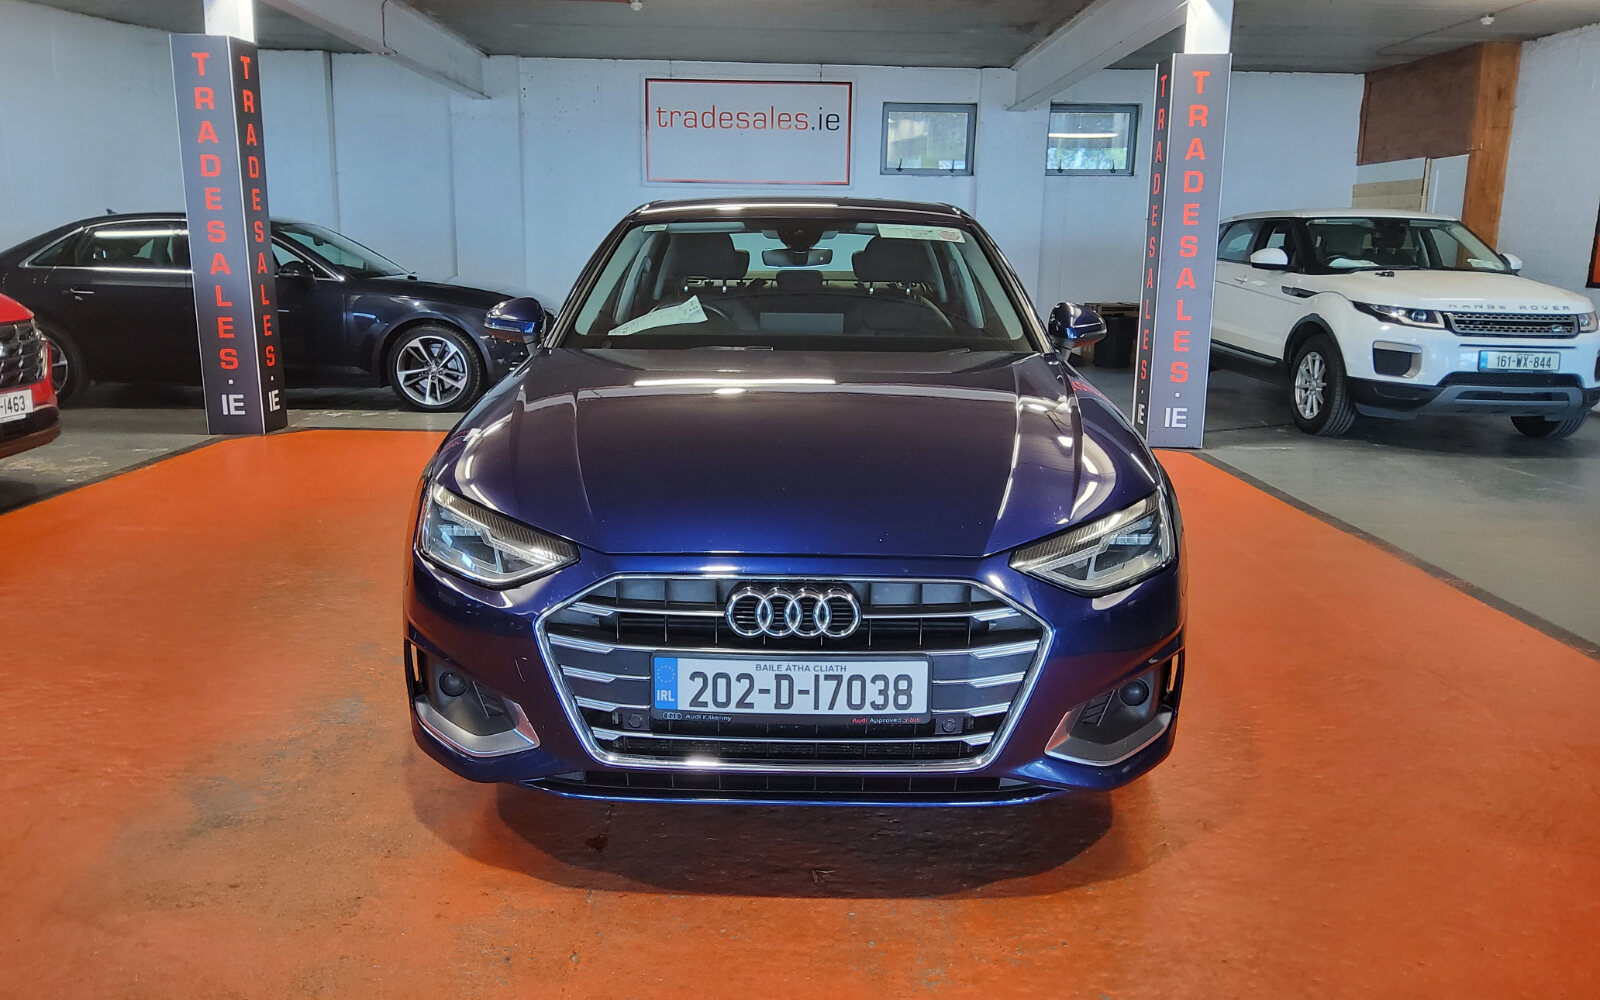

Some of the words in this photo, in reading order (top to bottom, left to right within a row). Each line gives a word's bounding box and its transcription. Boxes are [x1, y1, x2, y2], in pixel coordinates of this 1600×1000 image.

[655, 104, 840, 131] tradesales.ie
[1496, 355, 1552, 369] 161-WX-844
[755, 663, 783, 672] BAILE
[785, 662, 811, 672] ÁTHA
[813, 664, 847, 673] CLIATH
[656, 689, 675, 702] IRL
[688, 671, 913, 711] 202-D-17038
